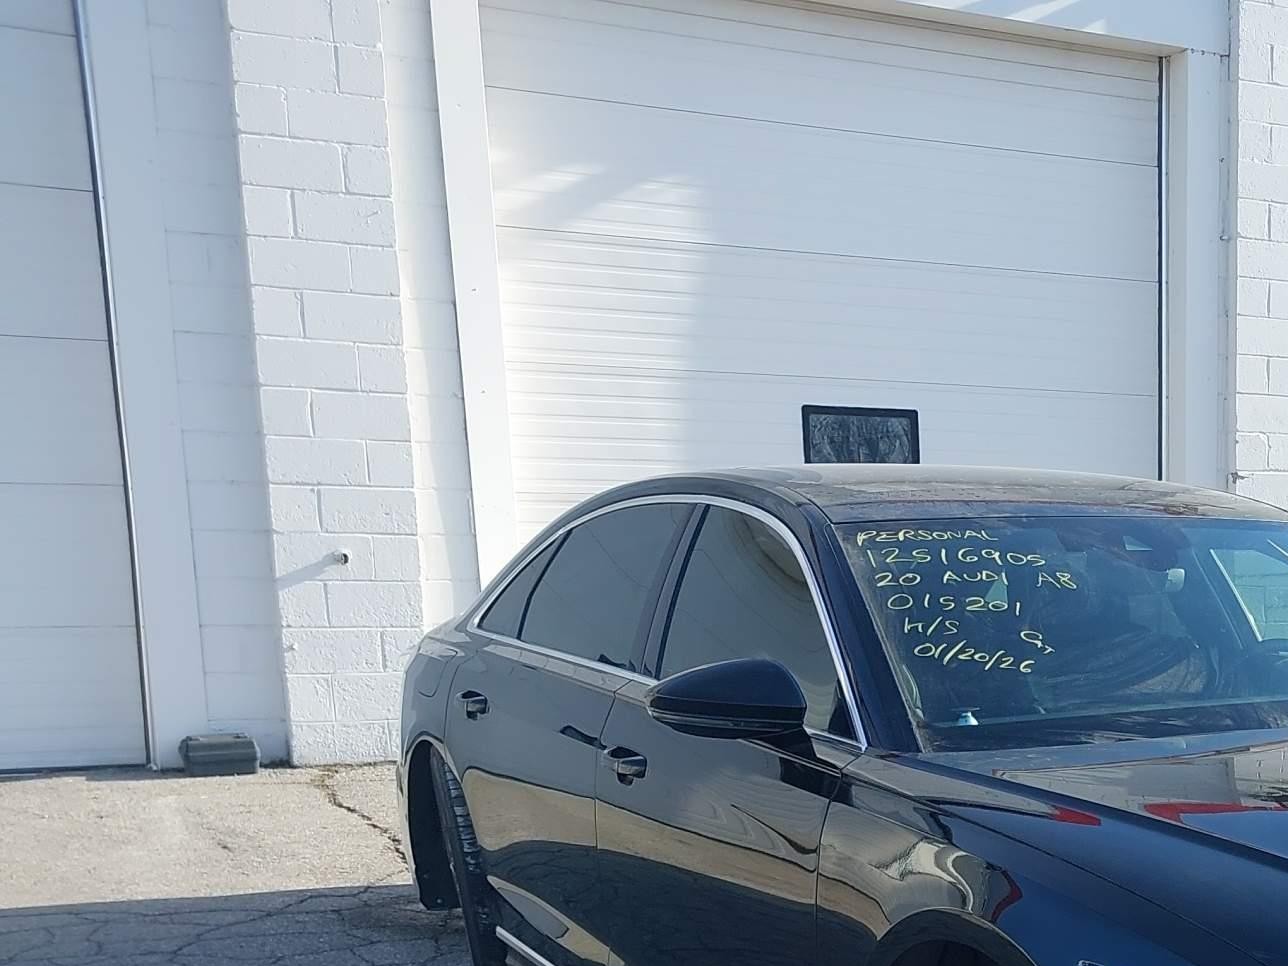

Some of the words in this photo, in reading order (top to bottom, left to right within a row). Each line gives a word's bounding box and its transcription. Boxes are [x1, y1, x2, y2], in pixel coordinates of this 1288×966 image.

[856, 529, 999, 546] PERSONAL
[866, 547, 1046, 568] 12516905
[874, 572, 921, 587] 20
[943, 570, 1008, 585] AUDI
[1036, 571, 1078, 590] A8
[887, 593, 1021, 616] 015201
[913, 640, 1036, 674] 01/20/26
